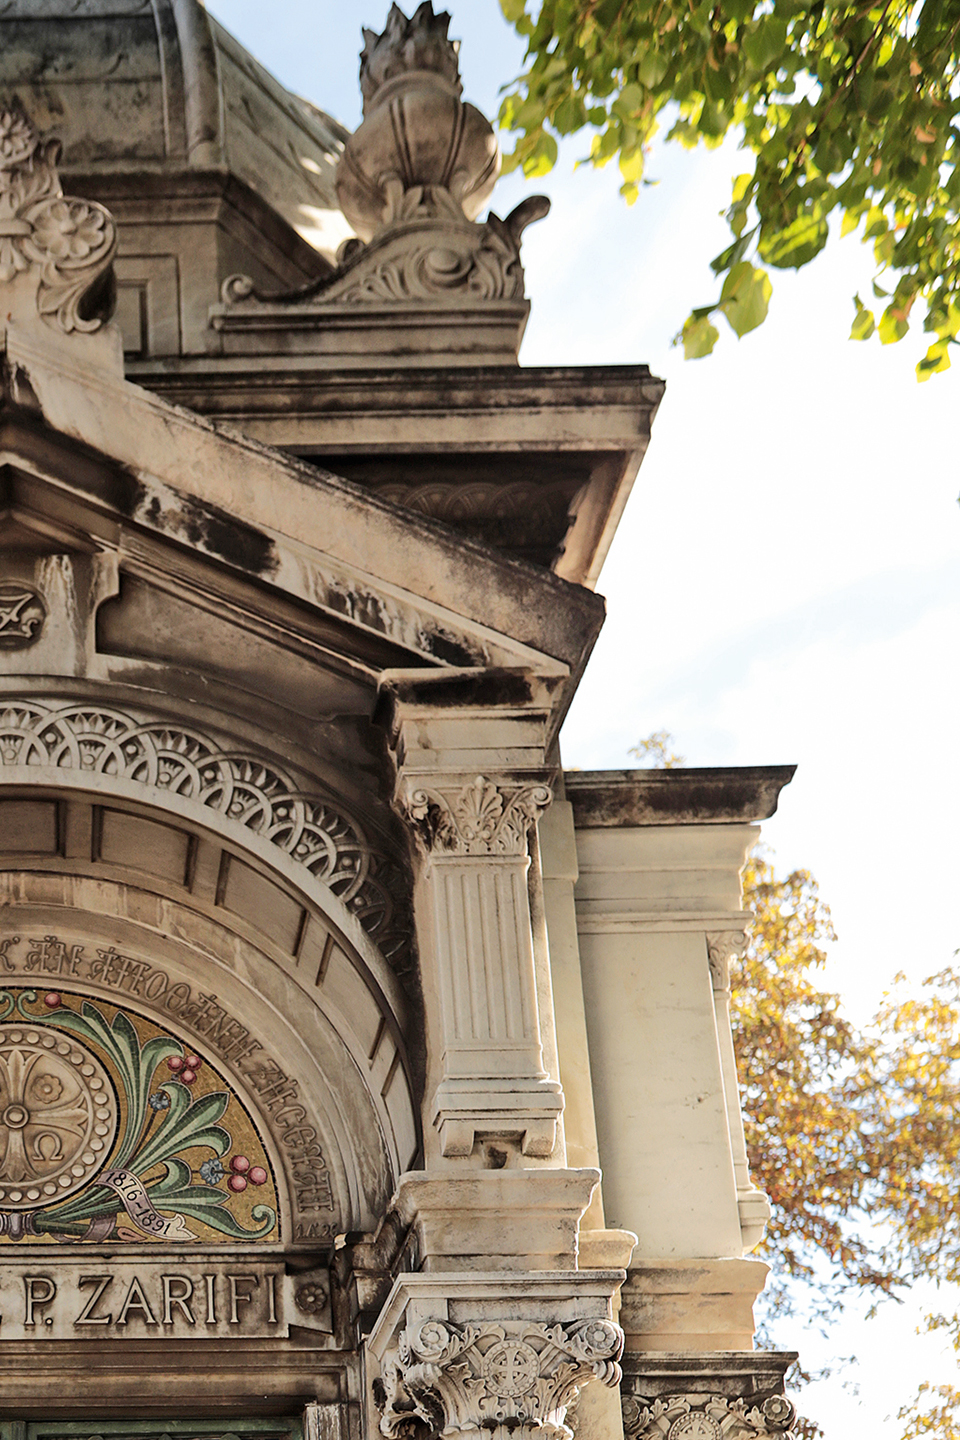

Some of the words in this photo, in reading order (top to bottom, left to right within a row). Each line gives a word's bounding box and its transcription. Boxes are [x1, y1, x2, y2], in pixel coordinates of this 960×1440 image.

[32, 1131, 64, 1161] Ω
[23, 1275, 57, 1326] P.
[73, 1274, 278, 1325] ZARIFI
